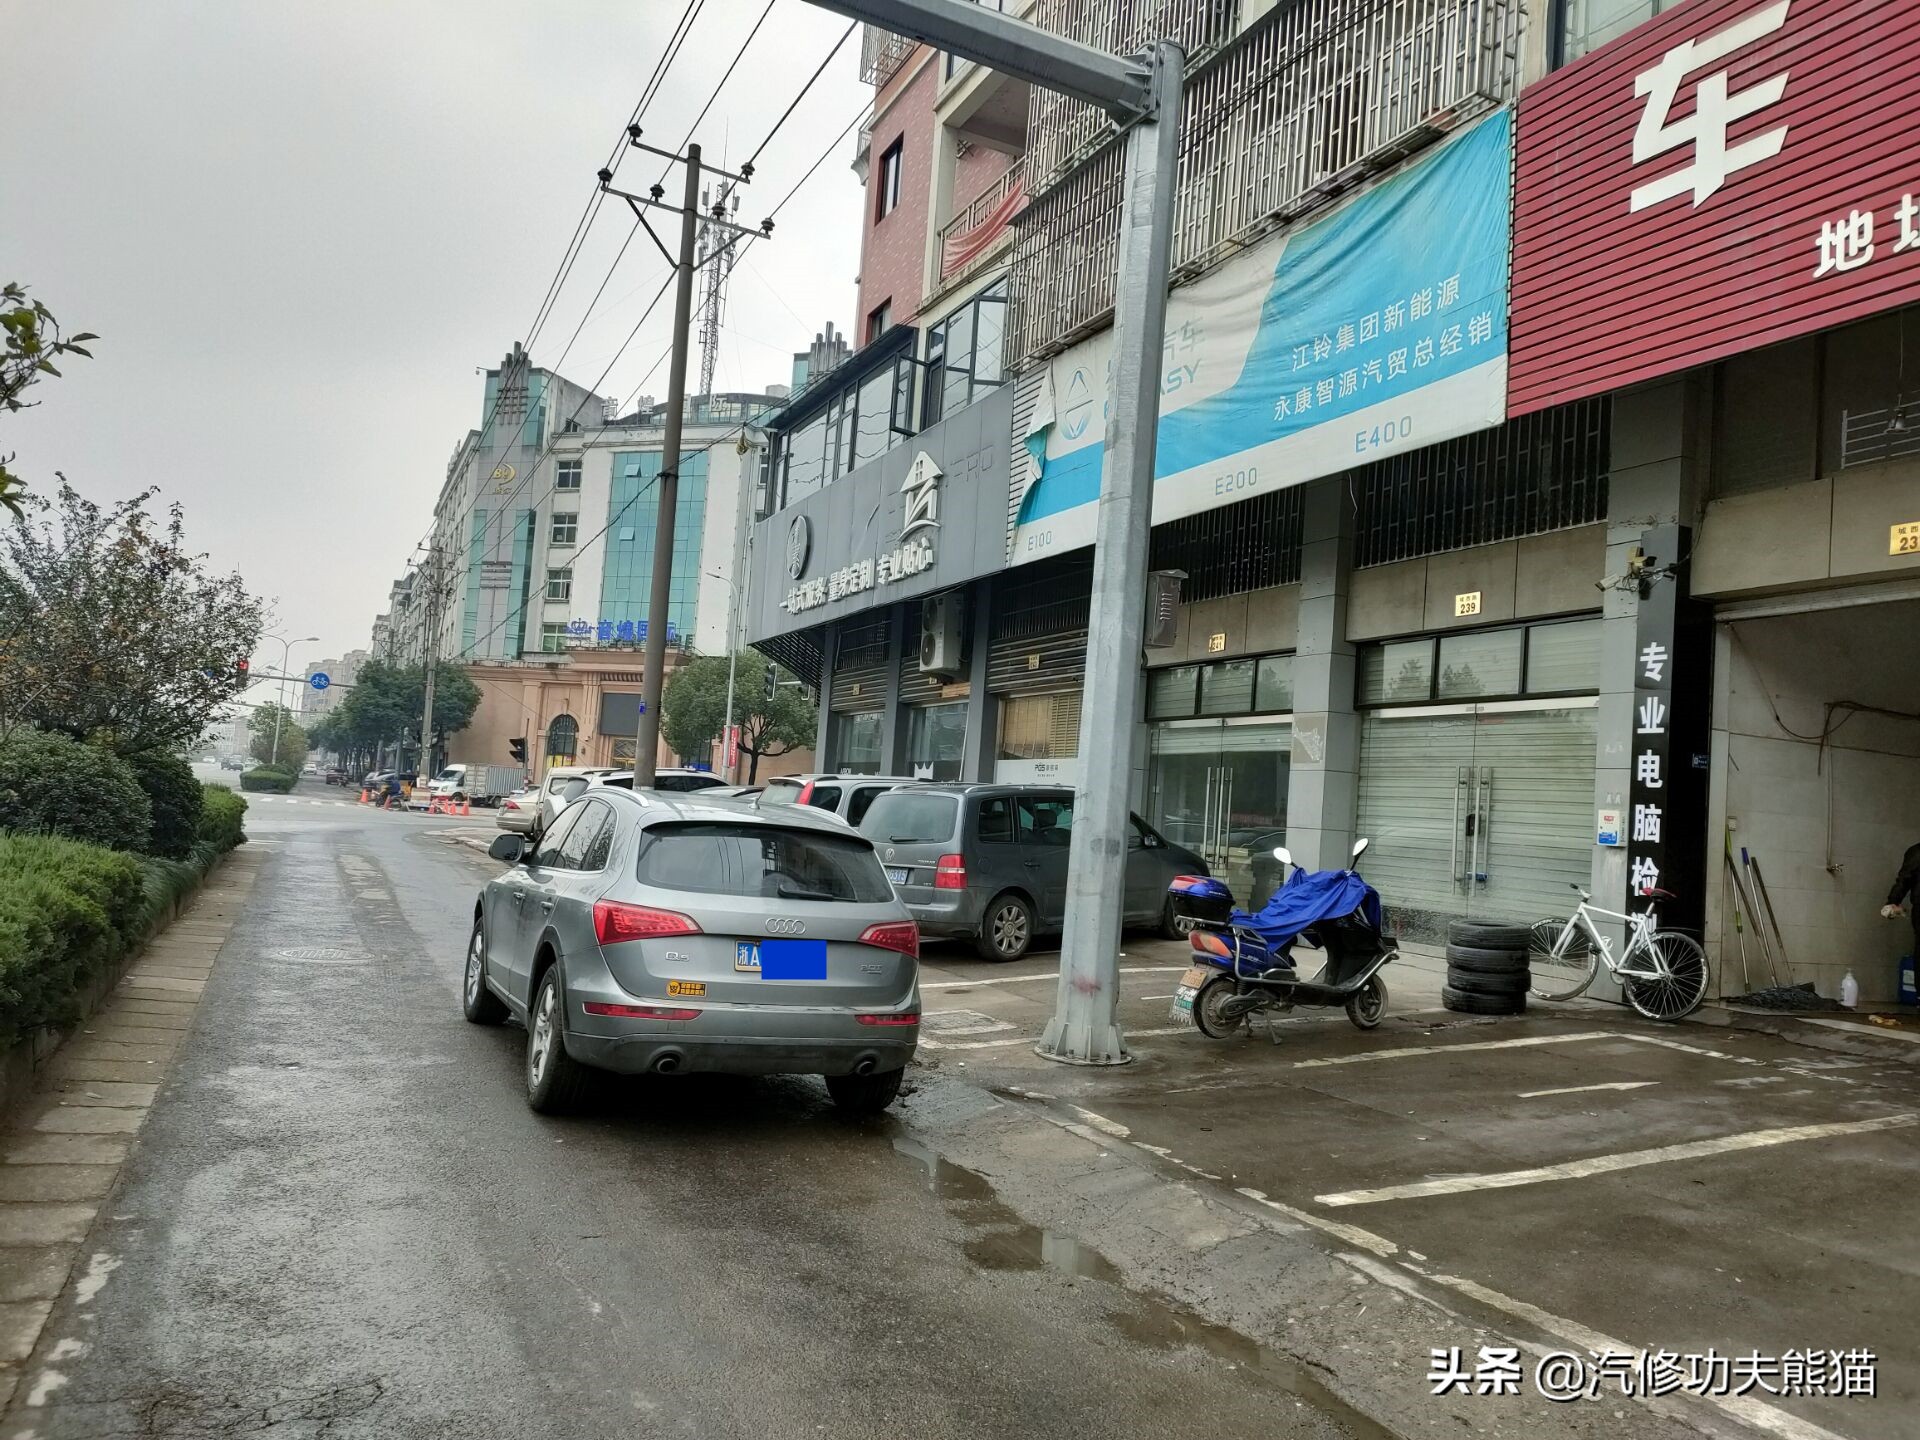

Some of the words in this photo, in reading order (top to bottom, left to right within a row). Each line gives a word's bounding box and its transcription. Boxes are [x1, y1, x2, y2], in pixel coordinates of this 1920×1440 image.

[1630, 0, 1791, 214] 车
[1291, 273, 1461, 373] 江铃集团新能源
[1273, 310, 1493, 422] 永康智源汽贸总经销
[1355, 415, 1412, 453] E400
[1215, 467, 1257, 496] E200
[1027, 530, 1052, 552] E100
[1460, 602, 1476, 614] 239
[665, 951, 689, 962] Q5
